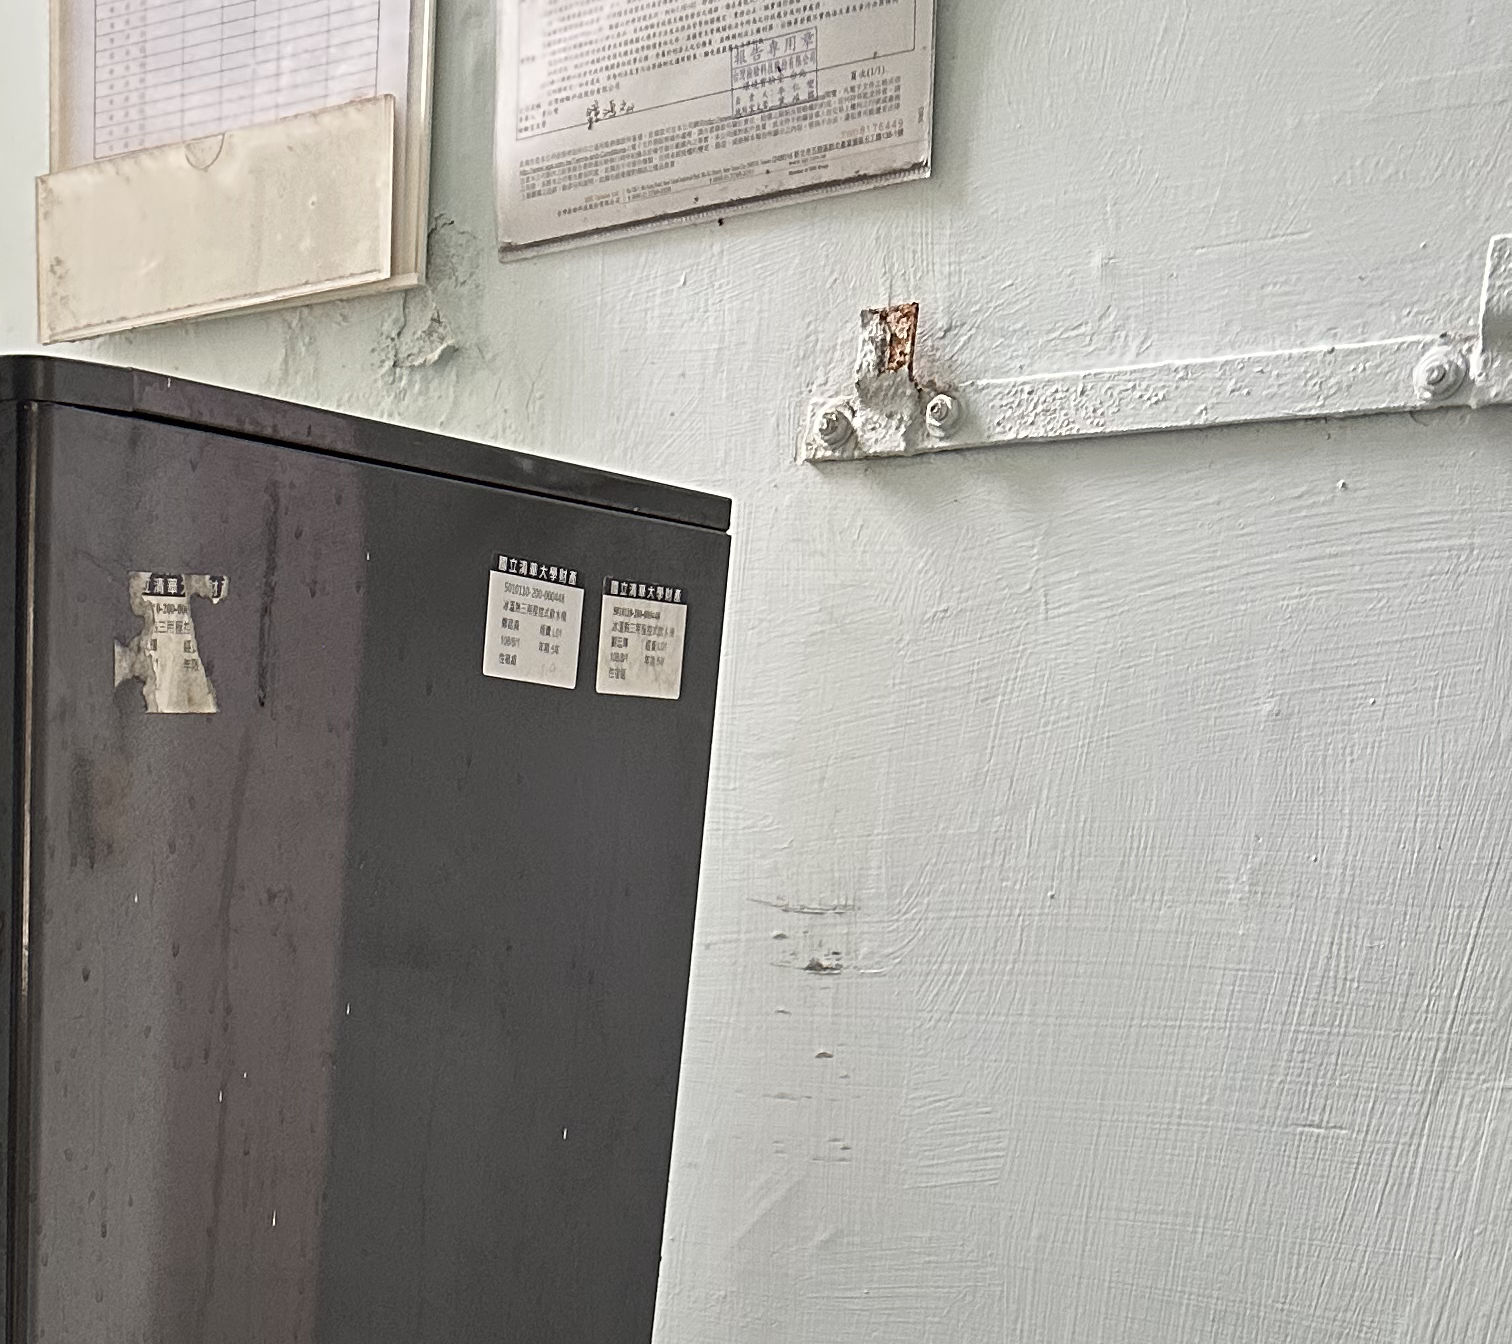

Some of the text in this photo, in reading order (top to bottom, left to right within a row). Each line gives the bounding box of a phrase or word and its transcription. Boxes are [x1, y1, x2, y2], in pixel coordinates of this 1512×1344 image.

[498, 555, 578, 585] 國立清華大學財產
[609, 579, 683, 603] 國立清華大學財產
